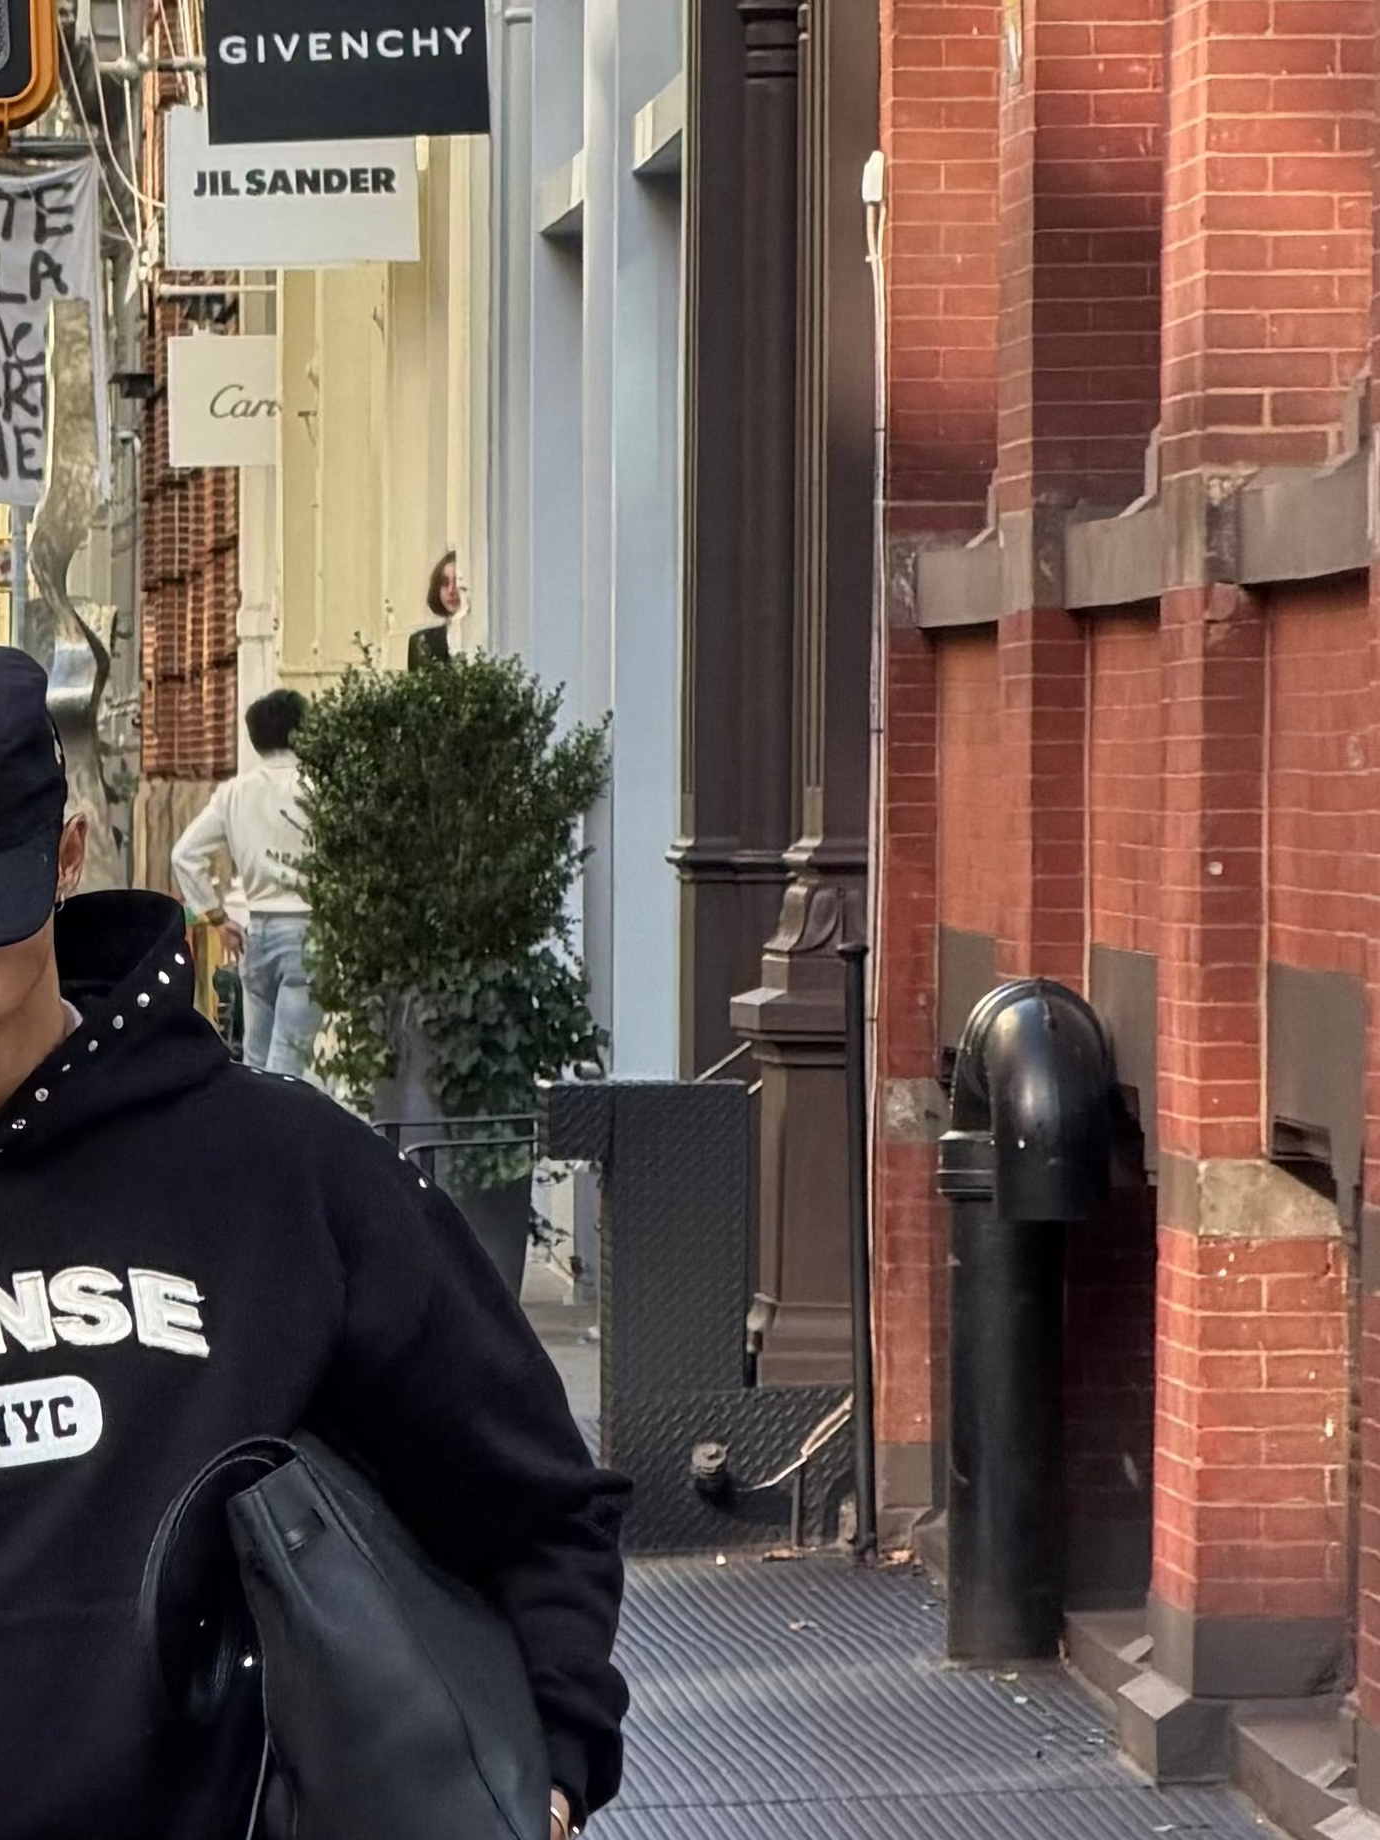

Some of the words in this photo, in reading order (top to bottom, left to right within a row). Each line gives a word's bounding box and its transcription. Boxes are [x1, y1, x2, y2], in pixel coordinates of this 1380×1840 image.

[218, 27, 472, 65] GIVENCHY
[193, 169, 241, 197] JIL
[244, 166, 398, 197] SANDER
